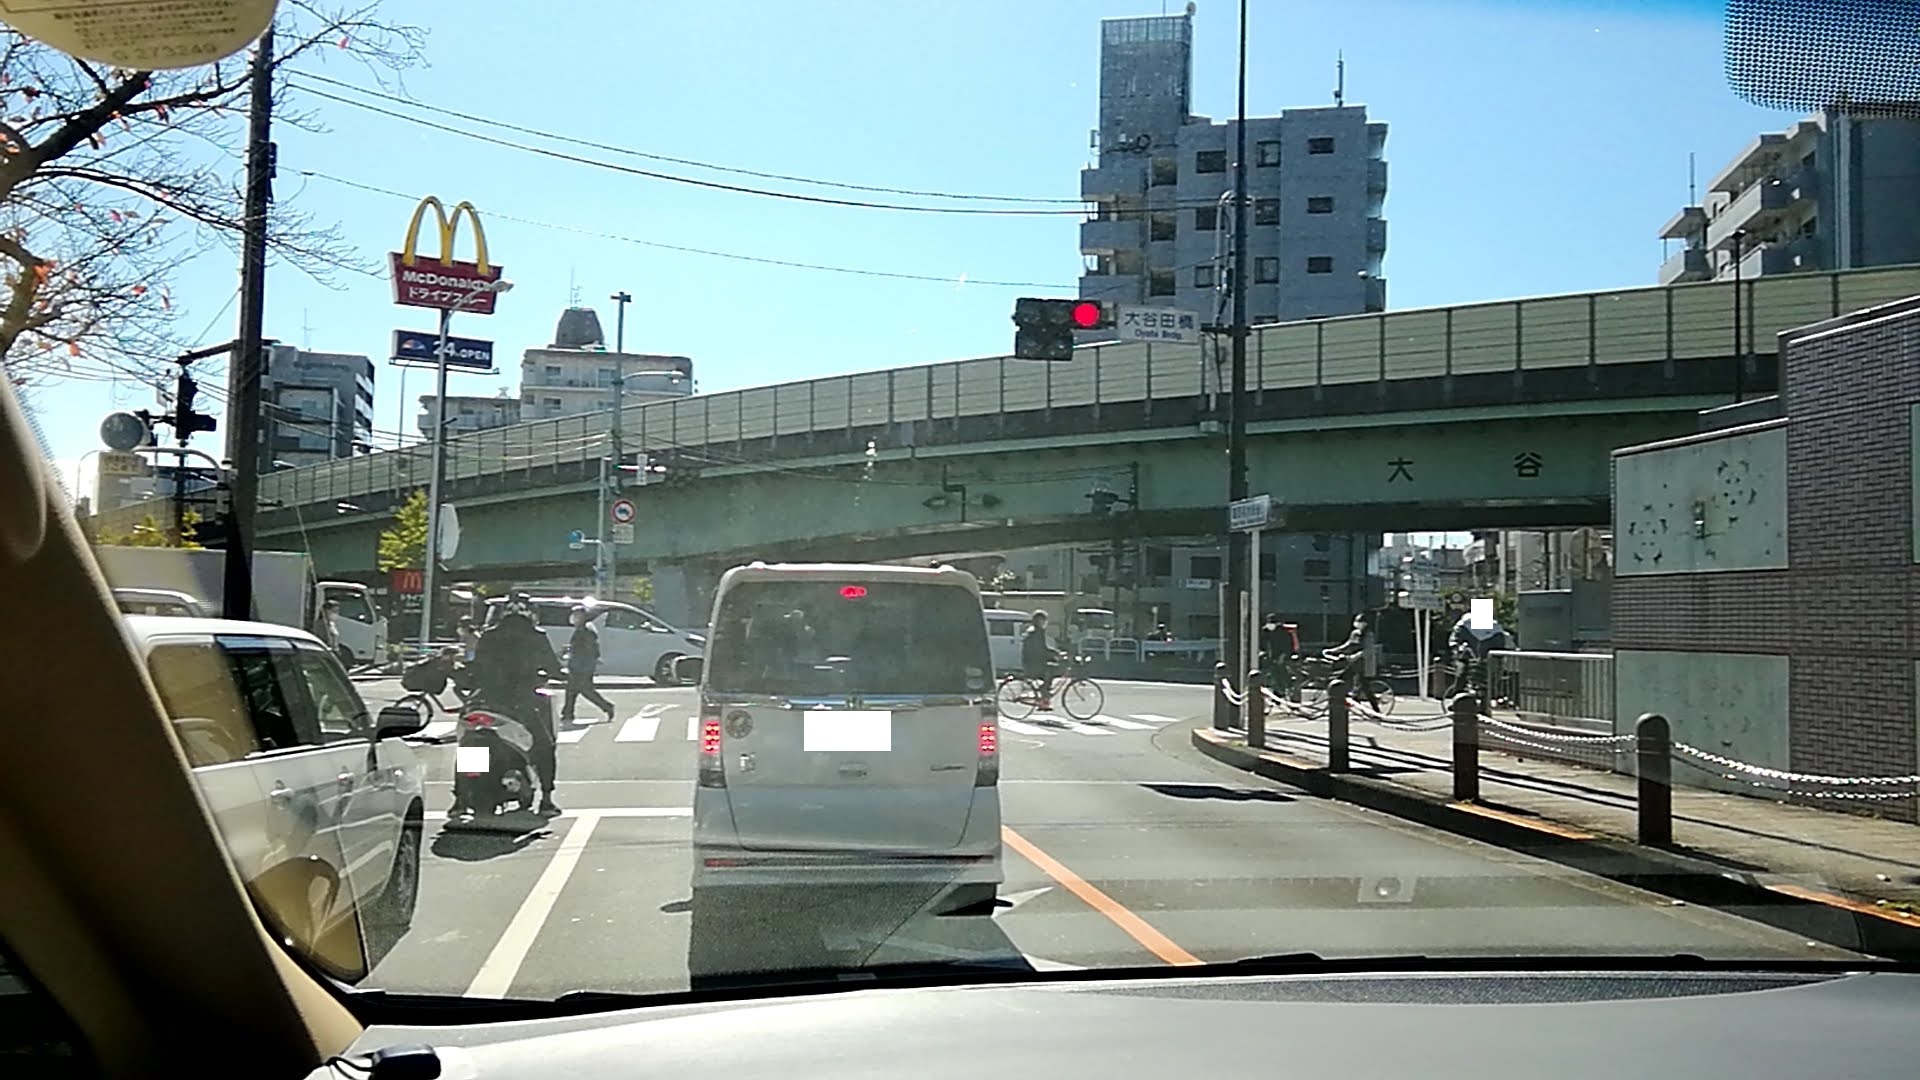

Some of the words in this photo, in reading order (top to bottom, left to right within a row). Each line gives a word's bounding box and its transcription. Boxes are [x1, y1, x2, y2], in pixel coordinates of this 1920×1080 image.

[1124, 311, 1194, 329] 大谷田橋
[460, 348, 490, 360] OPEN
